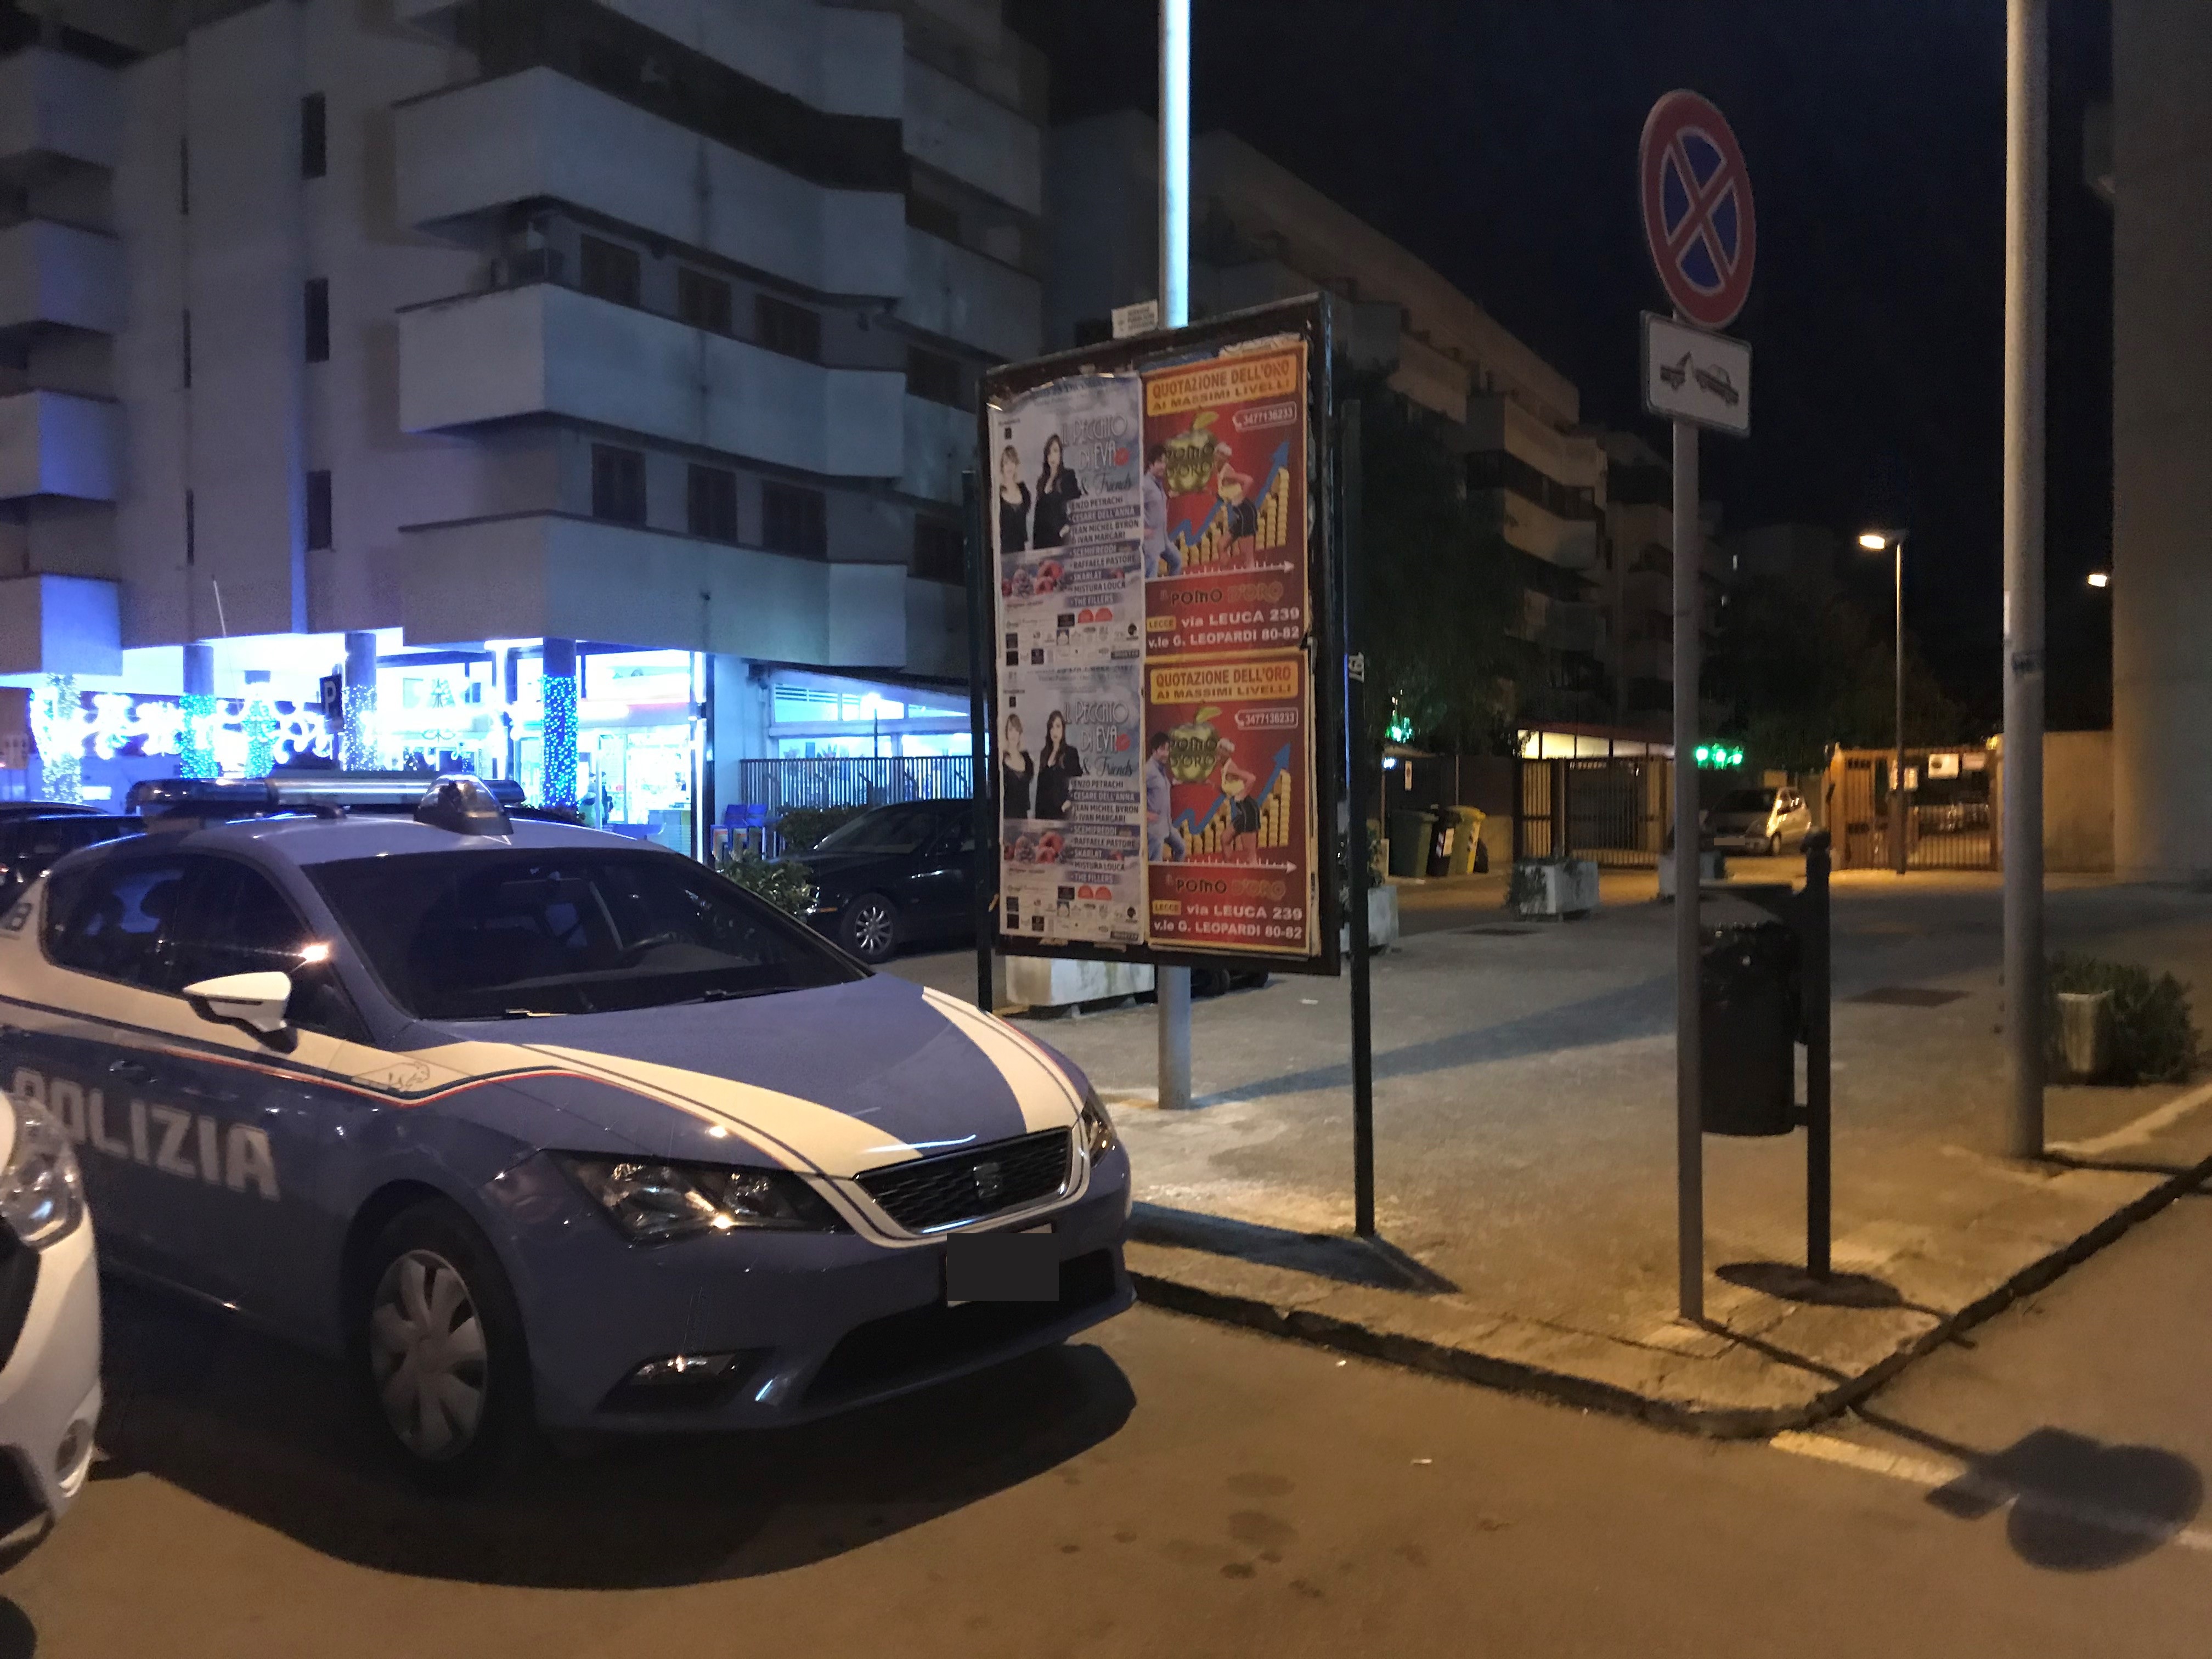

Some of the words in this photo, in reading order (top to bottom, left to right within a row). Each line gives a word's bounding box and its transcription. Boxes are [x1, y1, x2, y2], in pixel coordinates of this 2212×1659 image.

[1153, 371, 1227, 400] QUOTAZIONE
[1153, 401, 1166, 411] AI
[1171, 390, 1230, 408] MASSIMI
[1235, 380, 1289, 397] LIVELLI
[1115, 520, 1139, 528] BYRON
[1181, 616, 1204, 628] via
[1209, 610, 1264, 626] LEUCA
[1190, 629, 1257, 646] LEOPARDI
[1261, 625, 1300, 641] 80-82
[1156, 670, 1229, 687] QUOTAZIONE
[1233, 666, 1291, 683] DELL'ORO
[324, 680, 336, 714] P
[1174, 687, 1232, 698] MASSIMI
[1238, 684, 1291, 696] LIVELLI
[1115, 805, 1139, 814] BYRON
[1187, 904, 1209, 915] via
[1214, 905, 1267, 919] LEUCA
[1195, 921, 1260, 936] LEOPARDI
[1265, 925, 1302, 940] 80-82
[12, 1067, 280, 1201] POLIZIA
